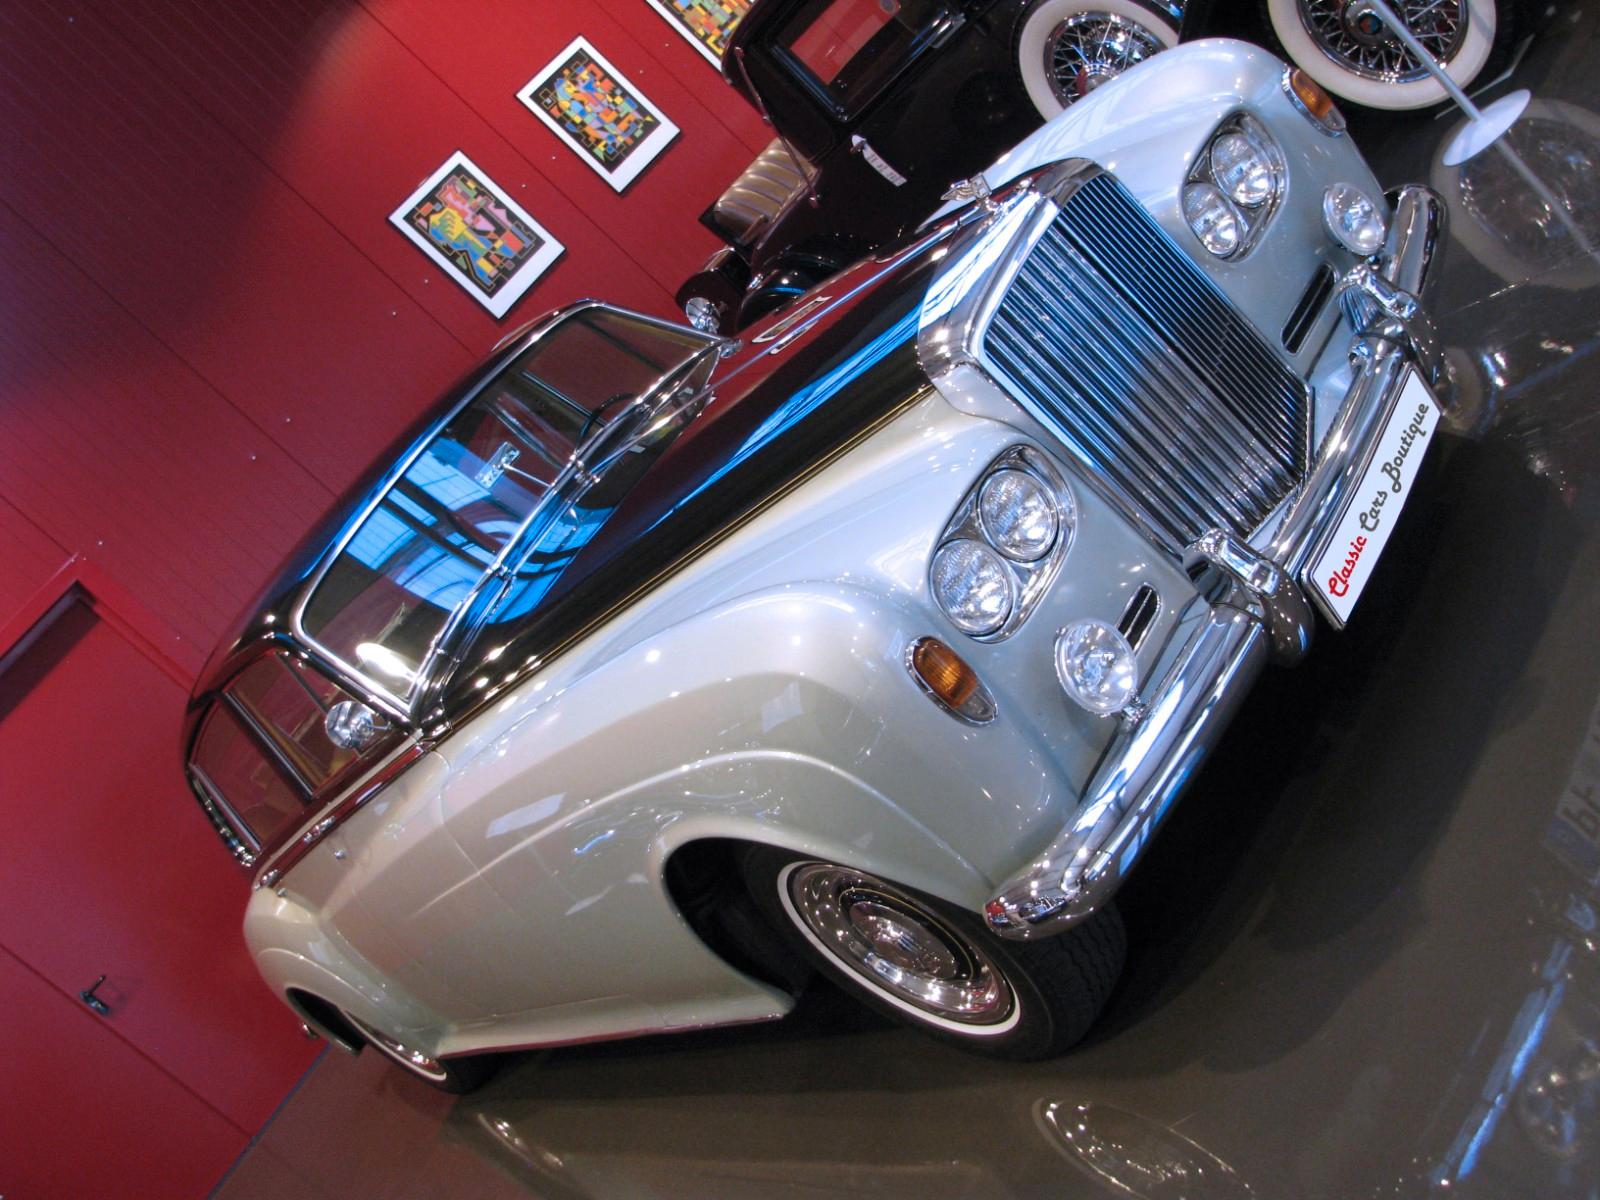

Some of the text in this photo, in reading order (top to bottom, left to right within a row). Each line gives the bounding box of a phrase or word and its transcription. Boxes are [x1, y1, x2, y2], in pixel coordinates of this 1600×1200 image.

[1328, 403, 1429, 597] Classic Cars Boutique
